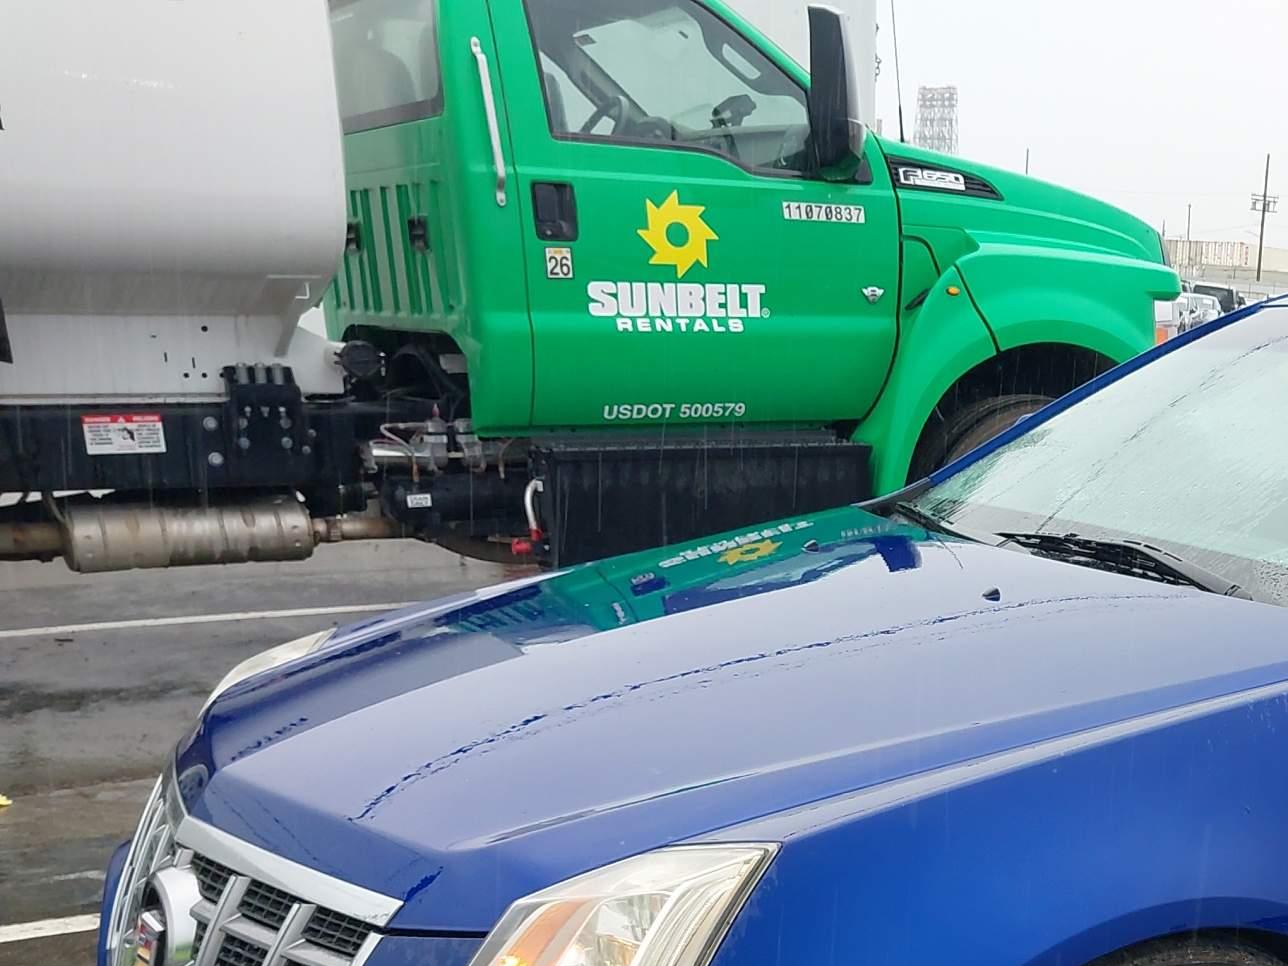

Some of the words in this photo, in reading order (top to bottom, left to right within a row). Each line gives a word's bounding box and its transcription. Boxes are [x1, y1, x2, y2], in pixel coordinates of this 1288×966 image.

[784, 203, 863, 222] 11070837
[549, 255, 571, 276] 26
[586, 281, 766, 318] SUNBELT
[615, 317, 745, 333] RENTALS
[603, 404, 676, 420] USDOT
[679, 402, 746, 418] 500579
